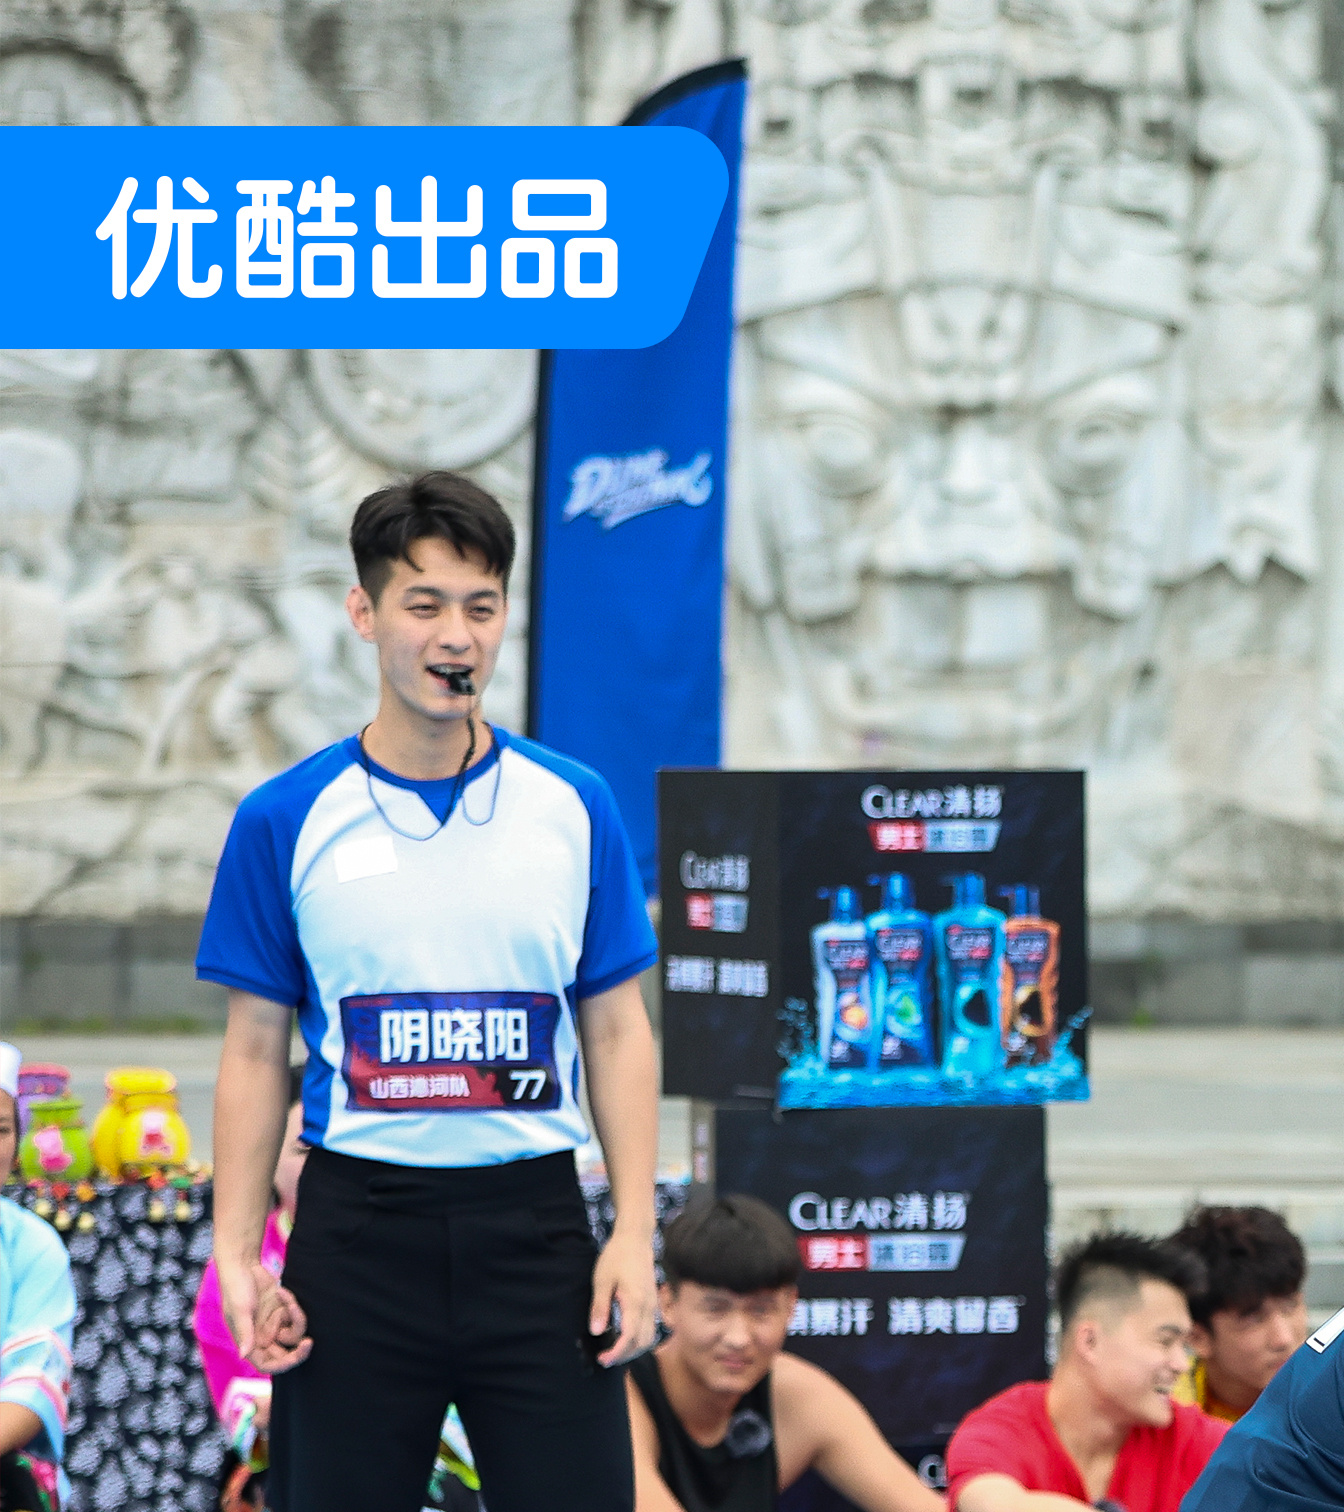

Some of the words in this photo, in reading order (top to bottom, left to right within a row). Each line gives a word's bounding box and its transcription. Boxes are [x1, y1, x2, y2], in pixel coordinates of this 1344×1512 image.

[379, 1008, 529, 1064] 阴晓阳
[508, 1069, 548, 1101] 77
